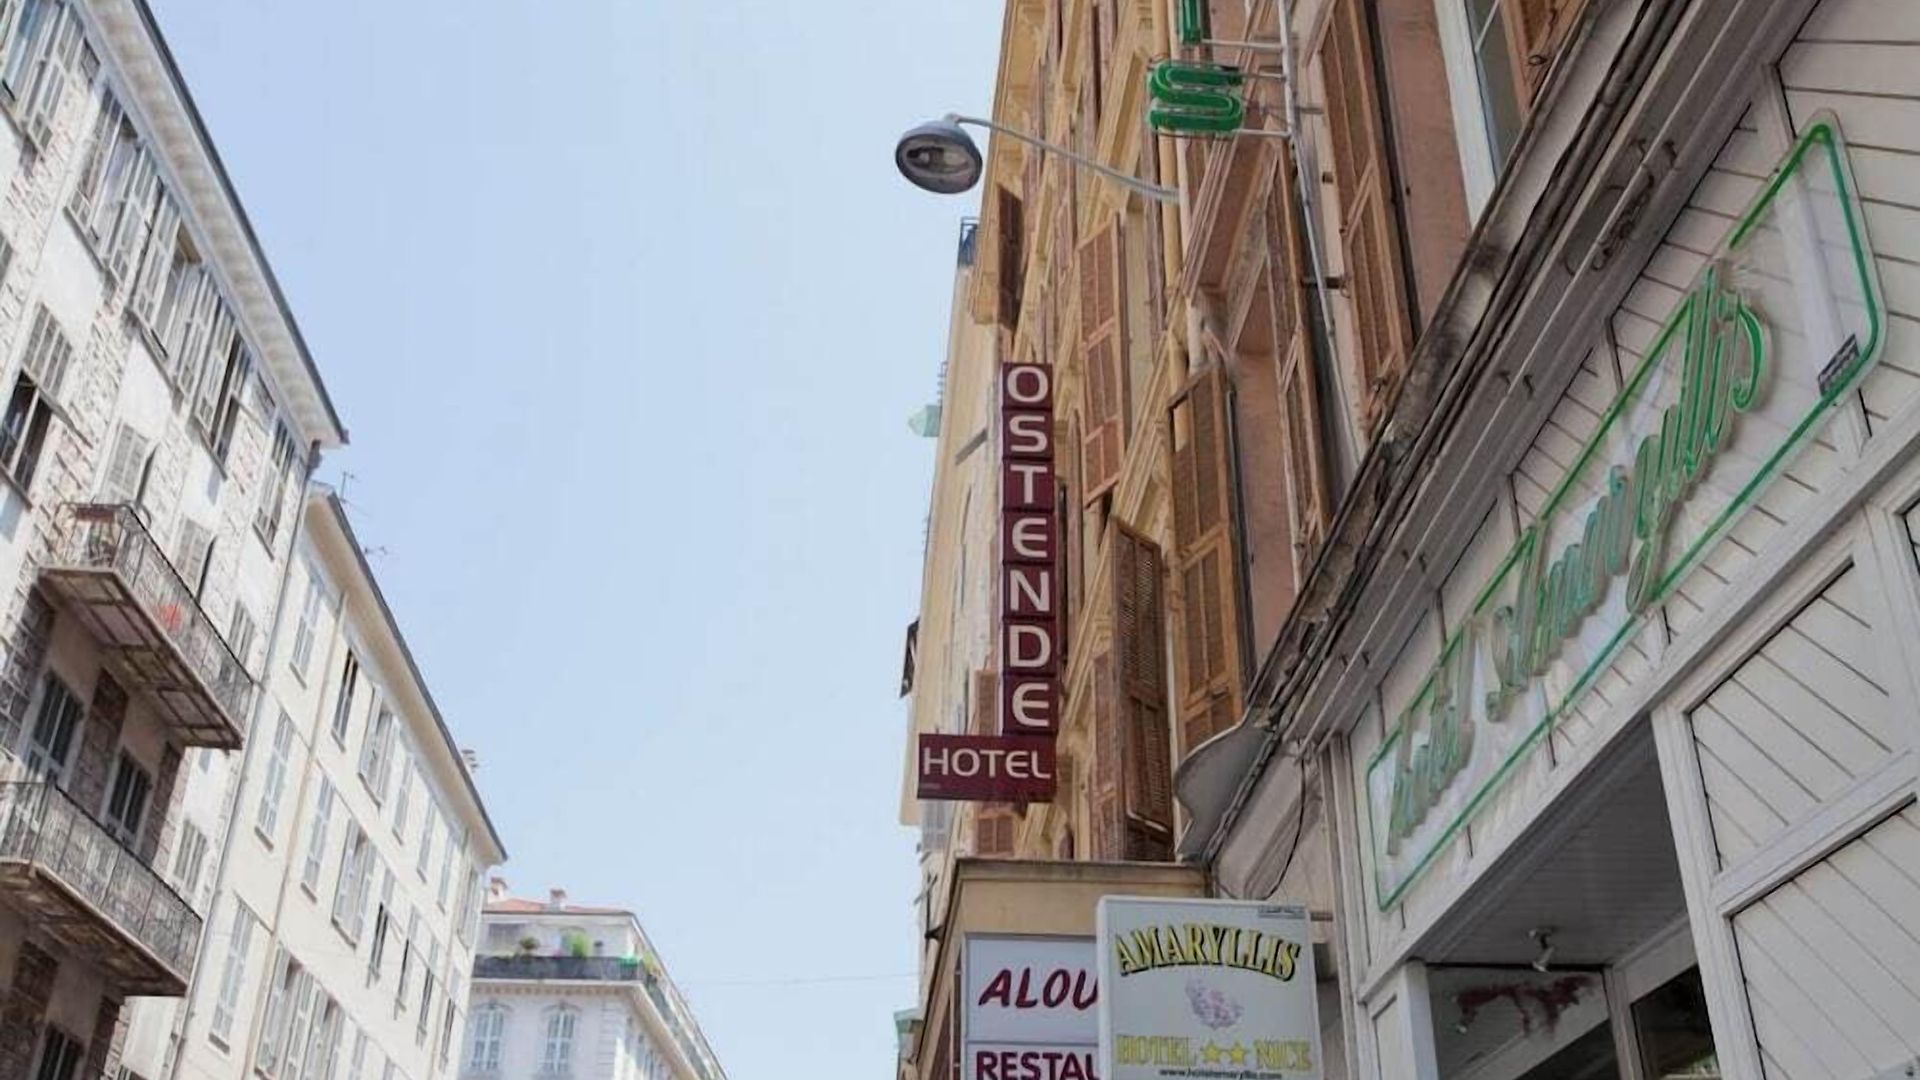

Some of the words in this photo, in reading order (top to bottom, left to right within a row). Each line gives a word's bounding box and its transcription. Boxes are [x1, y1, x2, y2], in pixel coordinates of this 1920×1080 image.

[1006, 365, 1052, 729] OSTENDE
[922, 747, 1052, 780] HOTEL
[1115, 922, 1301, 982] AMARYLLIS
[1115, 1034, 1198, 1067] HOTEL
[1253, 1037, 1313, 1071] NICE
